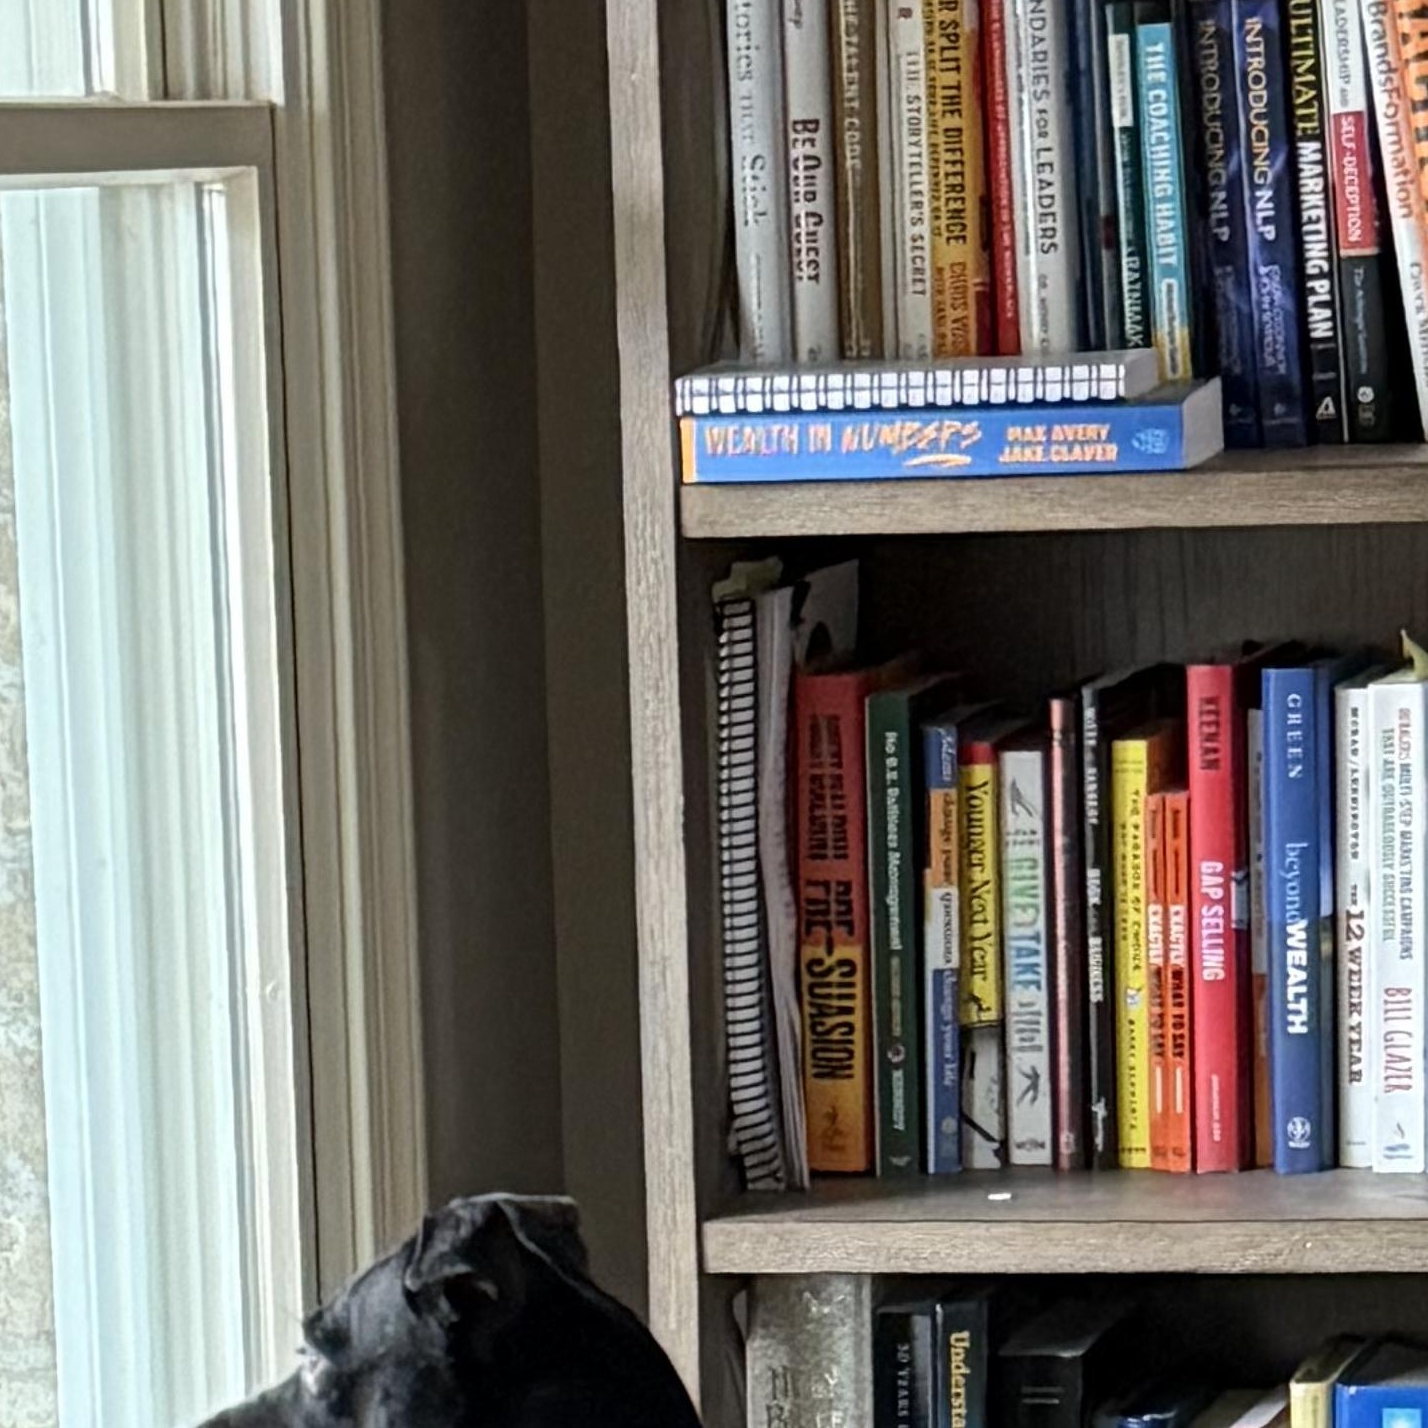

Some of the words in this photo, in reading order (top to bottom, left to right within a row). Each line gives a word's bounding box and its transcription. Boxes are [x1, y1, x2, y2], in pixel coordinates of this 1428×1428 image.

[939, 20, 961, 73] SPLIT
[1145, 42, 1165, 84] THE
[941, 80, 962, 118] THE
[1197, 20, 1225, 185] INTRODUCING
[1244, 17, 1271, 184] INTRODUCING
[1366, 1, 1416, 218] BrandsFormation
[1148, 89, 1172, 197] COACHING
[943, 127, 967, 246] DIFFERENCE
[1036, 147, 1058, 255] LEADERS
[1297, 141, 1329, 274] MARKETING
[1340, 115, 1362, 242] SELF-DECEPTION
[1156, 203, 1177, 265] HABIT
[1209, 190, 1229, 242] NLP
[1255, 190, 1275, 240] NLP
[910, 234, 927, 297] SECRET
[1309, 280, 1334, 339] PLAN
[704, 422, 798, 456] WEALTH
[999, 445, 1045, 463] JAKE
[1051, 442, 1118, 463] CLAVER
[1008, 426, 1046, 443] MAX
[1052, 424, 1109, 443] AVERY
[1198, 696, 1220, 771] KEENAN
[1286, 693, 1303, 779] GREEN
[962, 781, 988, 873] Younger
[965, 879, 988, 928] Next
[1008, 857, 1039, 917] GIVE
[1199, 861, 1223, 899] GAP
[1200, 905, 1225, 981] SELLING
[1345, 909, 1365, 942] 12
[805, 879, 857, 1080] PRE-SUASION
[966, 933, 991, 981] Year
[1009, 931, 1041, 993] TAKE
[1347, 947, 1363, 1017] WEEK
[1382, 987, 1411, 1024] BILL
[1347, 1021, 1365, 1085] YEAR
[1383, 1029, 1413, 1094] GLAZER
